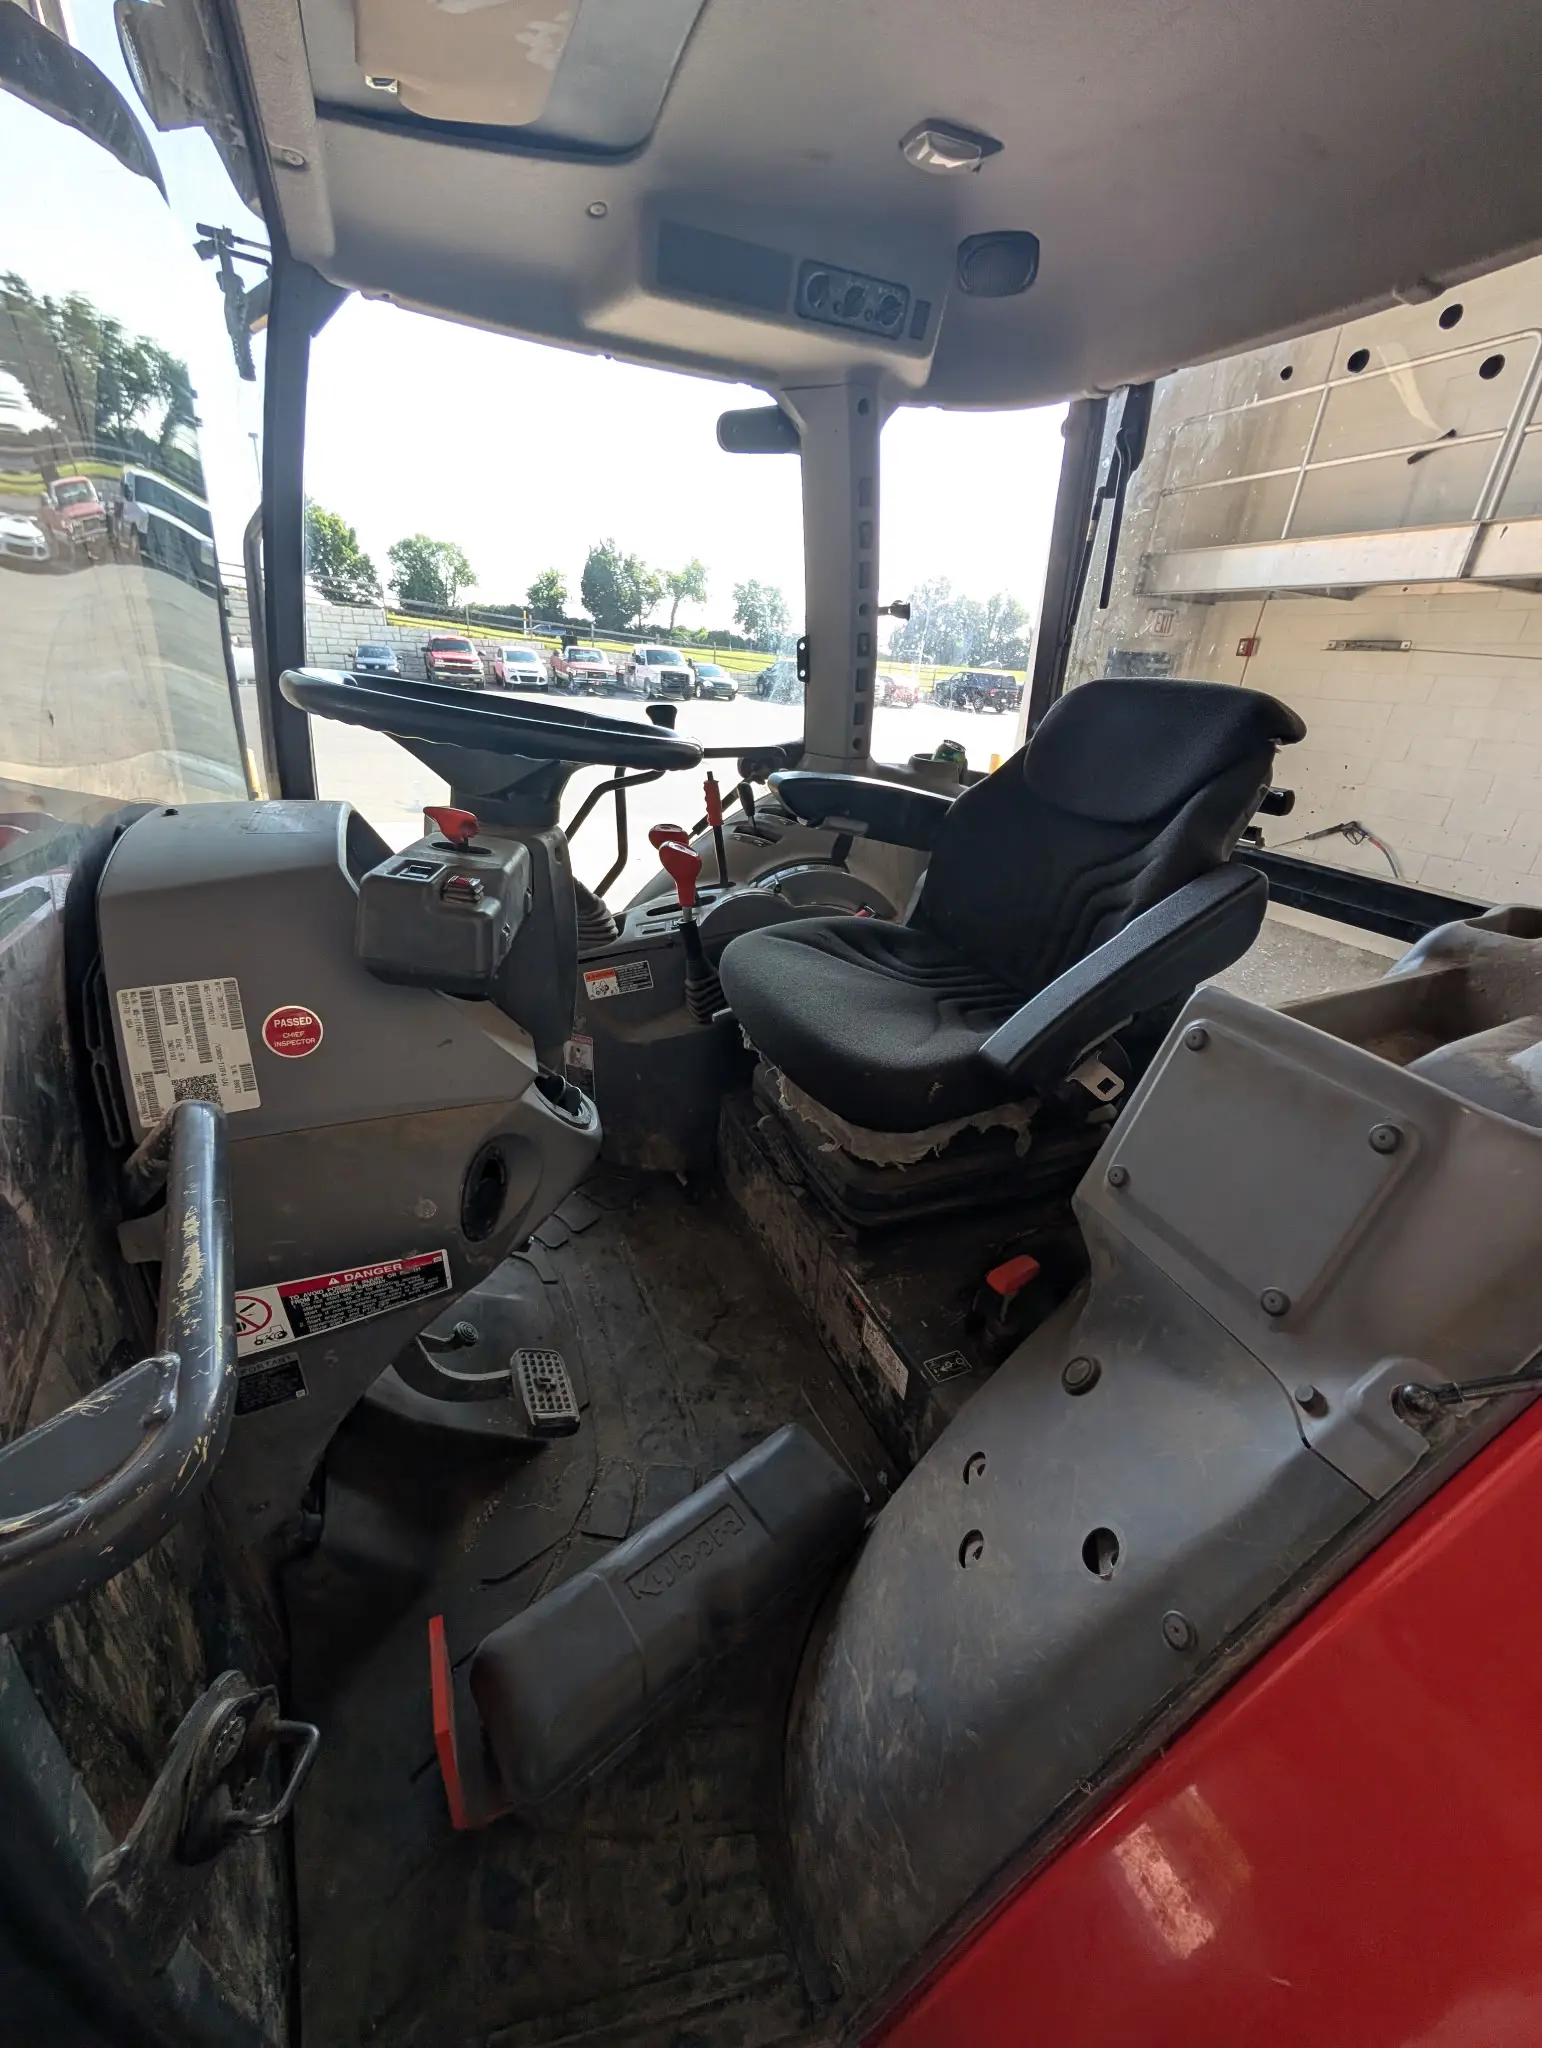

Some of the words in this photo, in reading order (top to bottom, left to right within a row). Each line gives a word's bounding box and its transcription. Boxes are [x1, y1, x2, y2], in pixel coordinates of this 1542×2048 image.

[1154, 613, 1175, 633] EXIT
[274, 1016, 312, 1028] PASSED
[274, 1038, 316, 1048] INSPECTOR
[344, 1262, 402, 1282] DANGER
[302, 1288, 324, 1298] AVOID
[627, 1519, 743, 1600] Kubota
